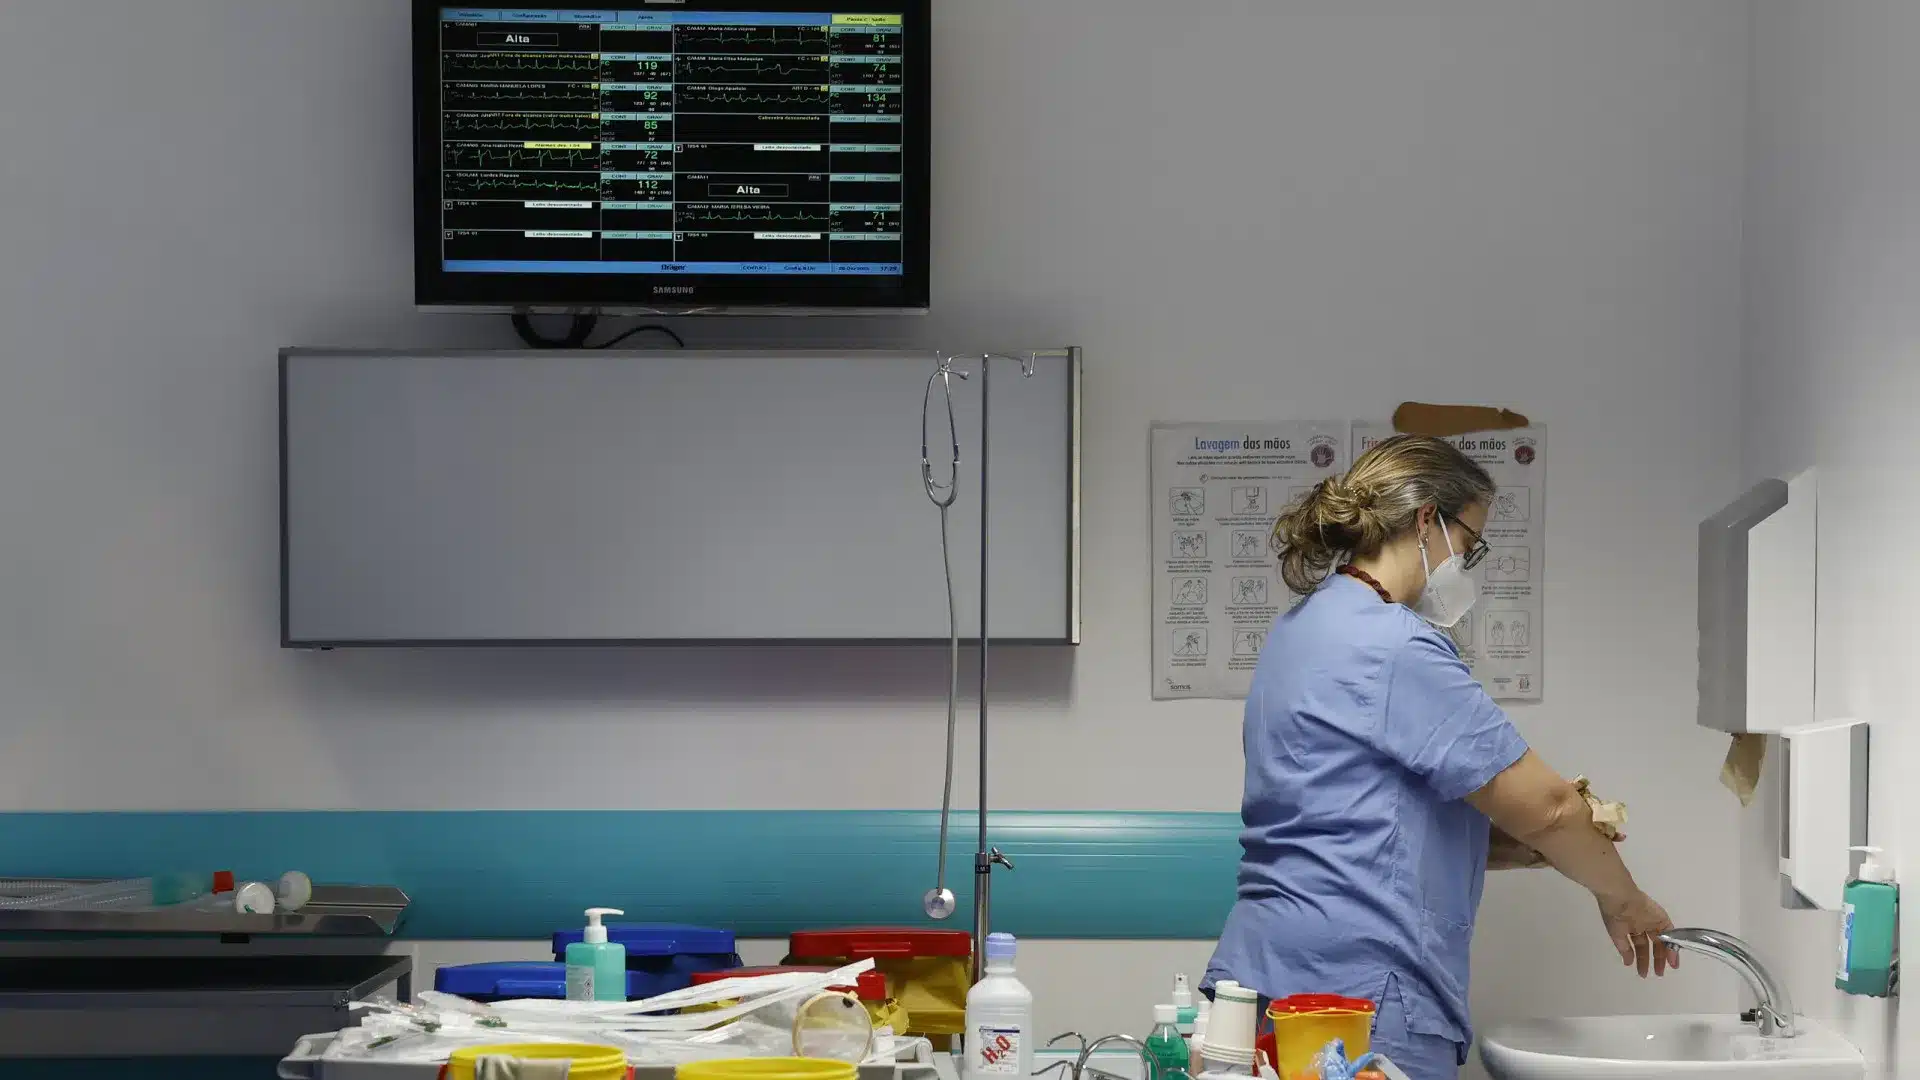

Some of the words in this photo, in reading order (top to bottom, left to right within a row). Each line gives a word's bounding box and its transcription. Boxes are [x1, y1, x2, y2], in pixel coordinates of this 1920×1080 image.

[506, 34, 530, 43] Alta
[638, 62, 658, 70] 119
[644, 91, 658, 100] 92
[867, 94, 886, 102] 134
[644, 121, 658, 130] 85
[644, 151, 658, 159] 72
[638, 180, 658, 189] 112
[736, 186, 760, 194] Alta
[873, 212, 885, 220] 71
[1195, 437, 1240, 453] Lavagem
[1243, 435, 1260, 450] das
[1264, 438, 1291, 450] mãos
[1459, 436, 1476, 450] das
[1479, 438, 1506, 450] mãos
